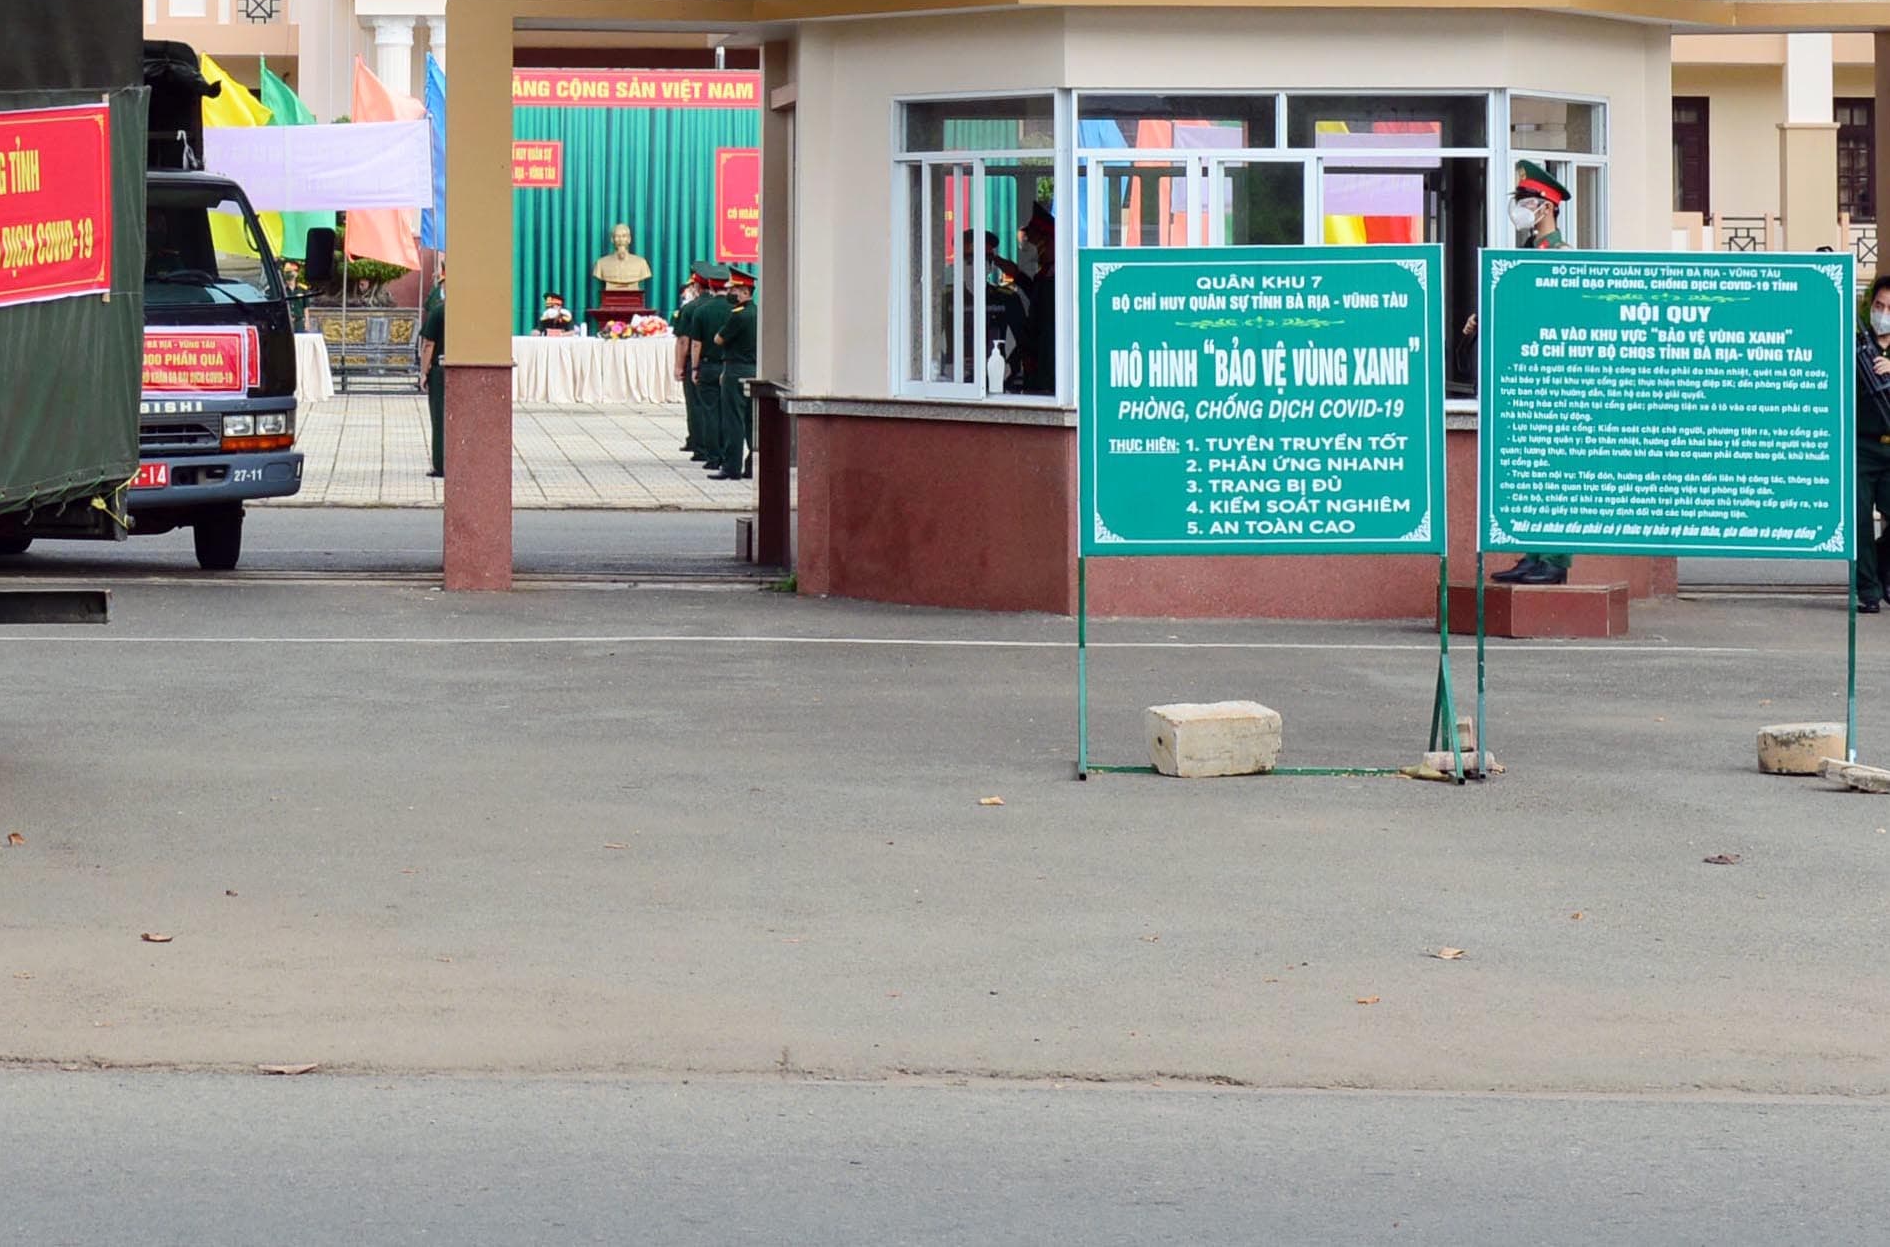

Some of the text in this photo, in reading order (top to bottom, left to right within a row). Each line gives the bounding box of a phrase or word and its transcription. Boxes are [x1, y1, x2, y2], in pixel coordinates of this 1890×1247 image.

[513, 76, 753, 102] ẢNG CỘNG SẢN VIỆT NAM
[8, 136, 40, 194] TỈNH
[2, 225, 34, 278] DỊCH
[36, 217, 94, 265] COVID-19
[1196, 273, 1323, 293] QUÂN KHU 7
[1620, 302, 1711, 325] NỘI QUY
[1539, 328, 1558, 340] RA
[1561, 327, 1587, 341] VÀO
[1590, 329, 1618, 342] KHU
[1620, 329, 1647, 344] VỰC
[1709, 329, 1745, 344] VÙNG
[1110, 336, 1420, 393] MÔ HÌNH “BẢO VỆ VÙNG XANH”
[1118, 395, 1405, 422] PHÒNG, CHỐNG DỊCH COVID-19
[1186, 438, 1200, 452] 1.
[1205, 434, 1274, 452] TUYÊN
[1368, 433, 1408, 450] TỐT
[1186, 459, 1202, 472] 2.
[1272, 455, 1321, 472] ỨNG
[1327, 457, 1404, 471] NHANH
[234, 469, 263, 482] 27-11
[1186, 475, 1342, 496] 3. TRANG BỊ ĐỦ
[1186, 495, 1411, 514] 4. KIỂM SOÁT NGHIÊM
[1187, 517, 1356, 535] 5. AN TOÀN CAO
